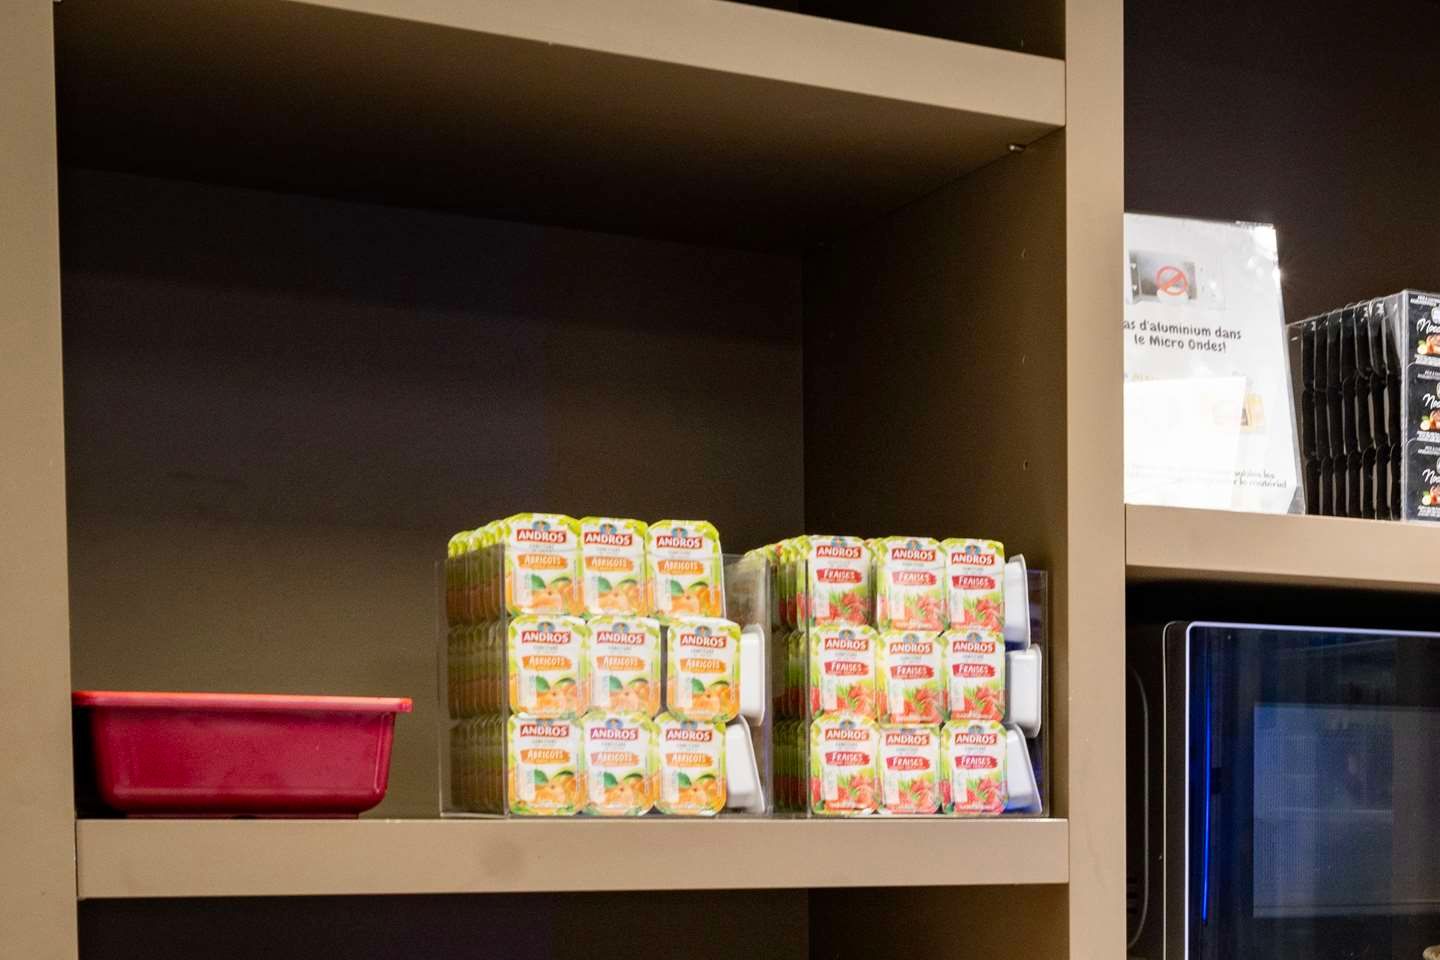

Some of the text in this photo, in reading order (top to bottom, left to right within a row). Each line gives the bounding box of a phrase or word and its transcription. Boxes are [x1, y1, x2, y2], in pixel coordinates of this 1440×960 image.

[1140, 319, 1212, 337] d'aluminium
[1215, 325, 1242, 340] dans
[1134, 333, 1146, 345] le
[1150, 335, 1185, 349] Micro
[519, 529, 564, 543] ANDROS
[585, 533, 631, 546] ANDROS
[657, 537, 702, 549] ANDROS
[818, 547, 860, 558] ANDROS
[893, 549, 934, 560] ANDROS
[952, 554, 992, 565] ANDROS
[523, 632, 570, 644] ANDROS
[597, 632, 645, 644] ANDROS
[680, 635, 725, 648] ANDROS
[826, 639, 867, 650] ANDROS
[891, 643, 931, 654] ANDROS
[954, 642, 994, 653] ANDROS
[521, 725, 568, 737] ANDROS
[592, 728, 638, 740] ANDROS
[667, 729, 712, 741] ANDROS
[826, 729, 868, 740] ANDROS
[887, 734, 928, 745] ANDROS
[955, 733, 997, 744] ANDROS
